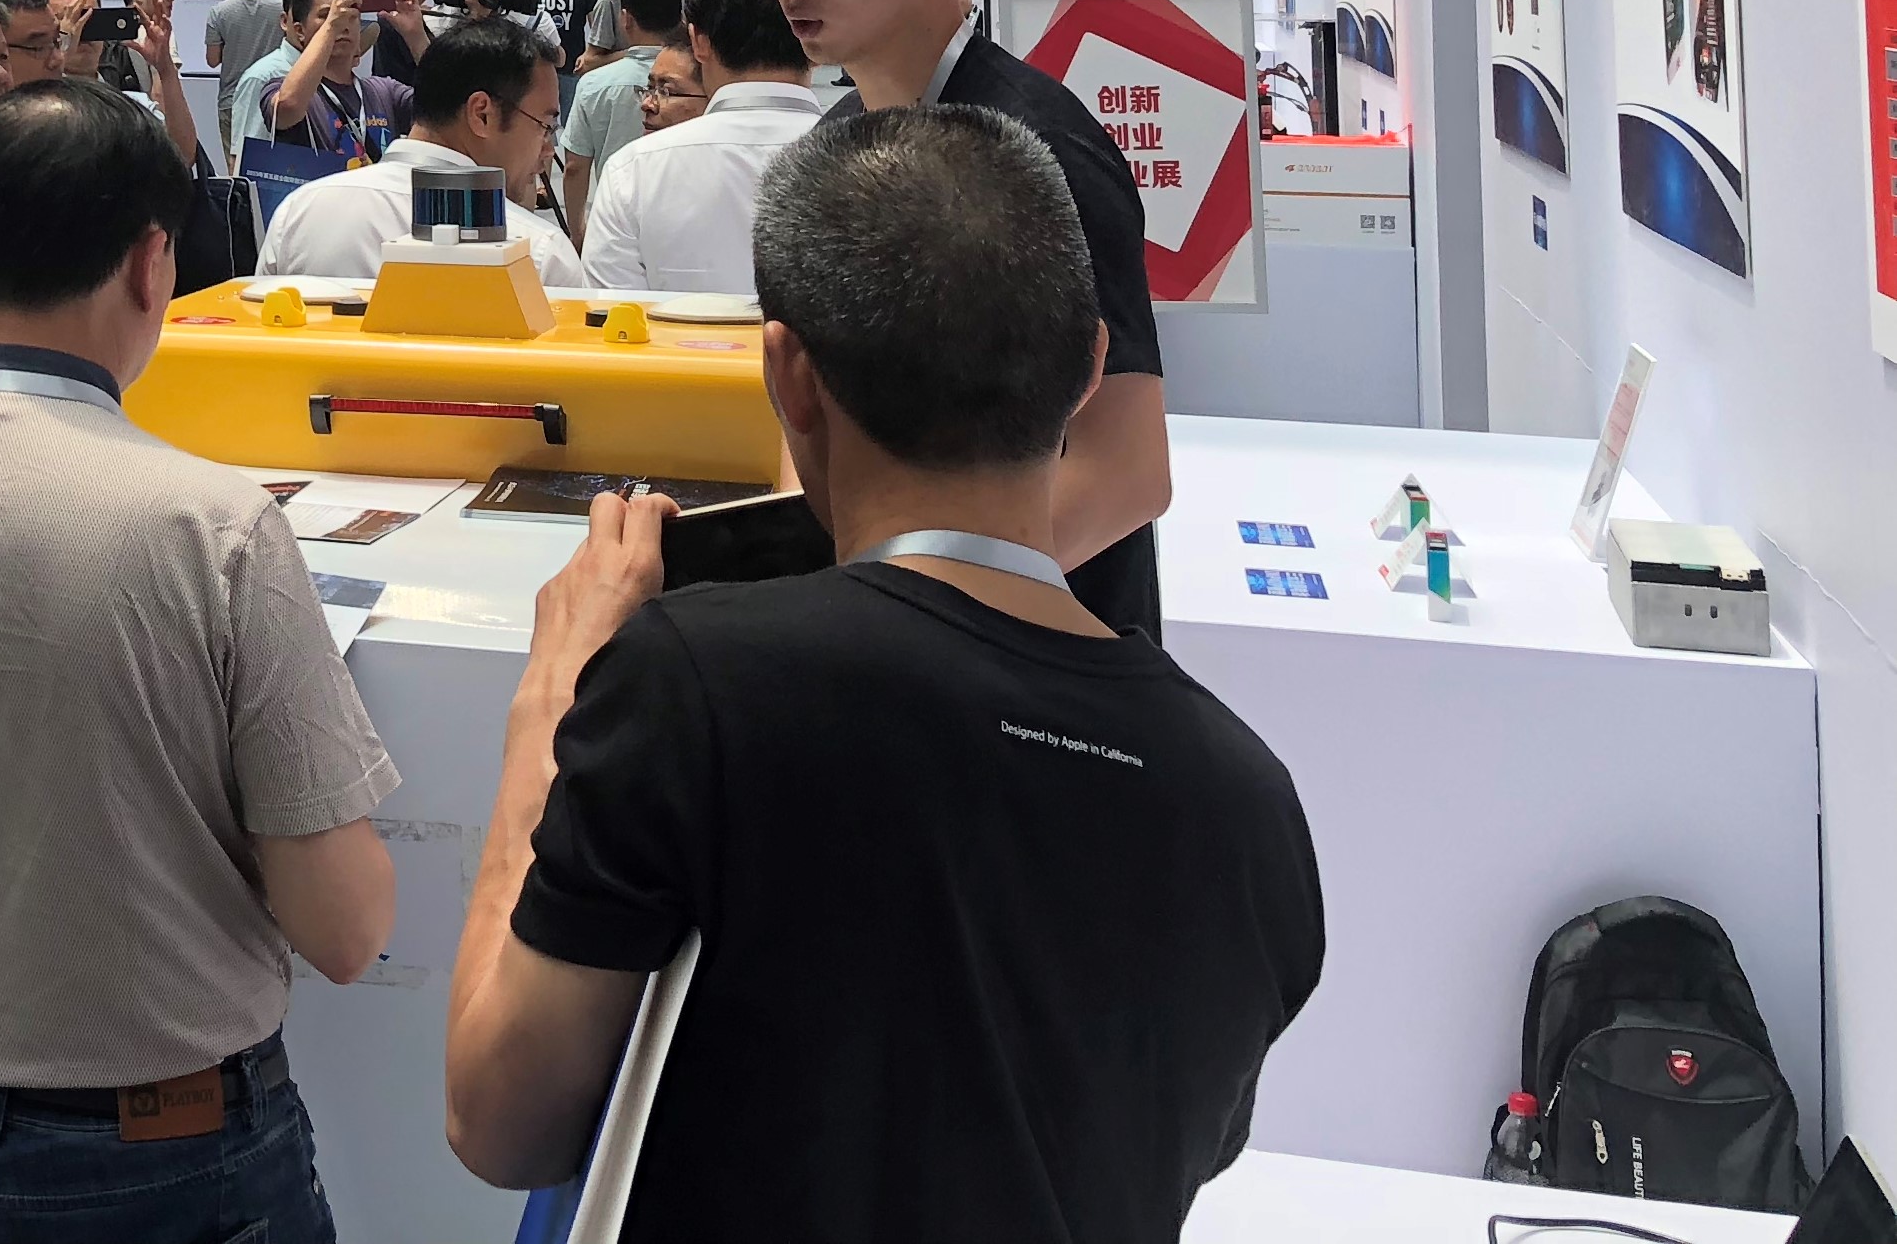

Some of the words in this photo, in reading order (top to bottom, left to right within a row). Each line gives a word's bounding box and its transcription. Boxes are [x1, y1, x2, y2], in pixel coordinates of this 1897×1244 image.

[1097, 85, 1161, 114] 创新
[1001, 720, 1045, 741] Designed
[1047, 732, 1059, 747] by
[1061, 736, 1088, 753] Apple
[1090, 741, 1100, 755] in
[1101, 746, 1144, 768] California
[163, 1088, 214, 1107] PLAYBOY
[1632, 1136, 1643, 1160] LIFE
